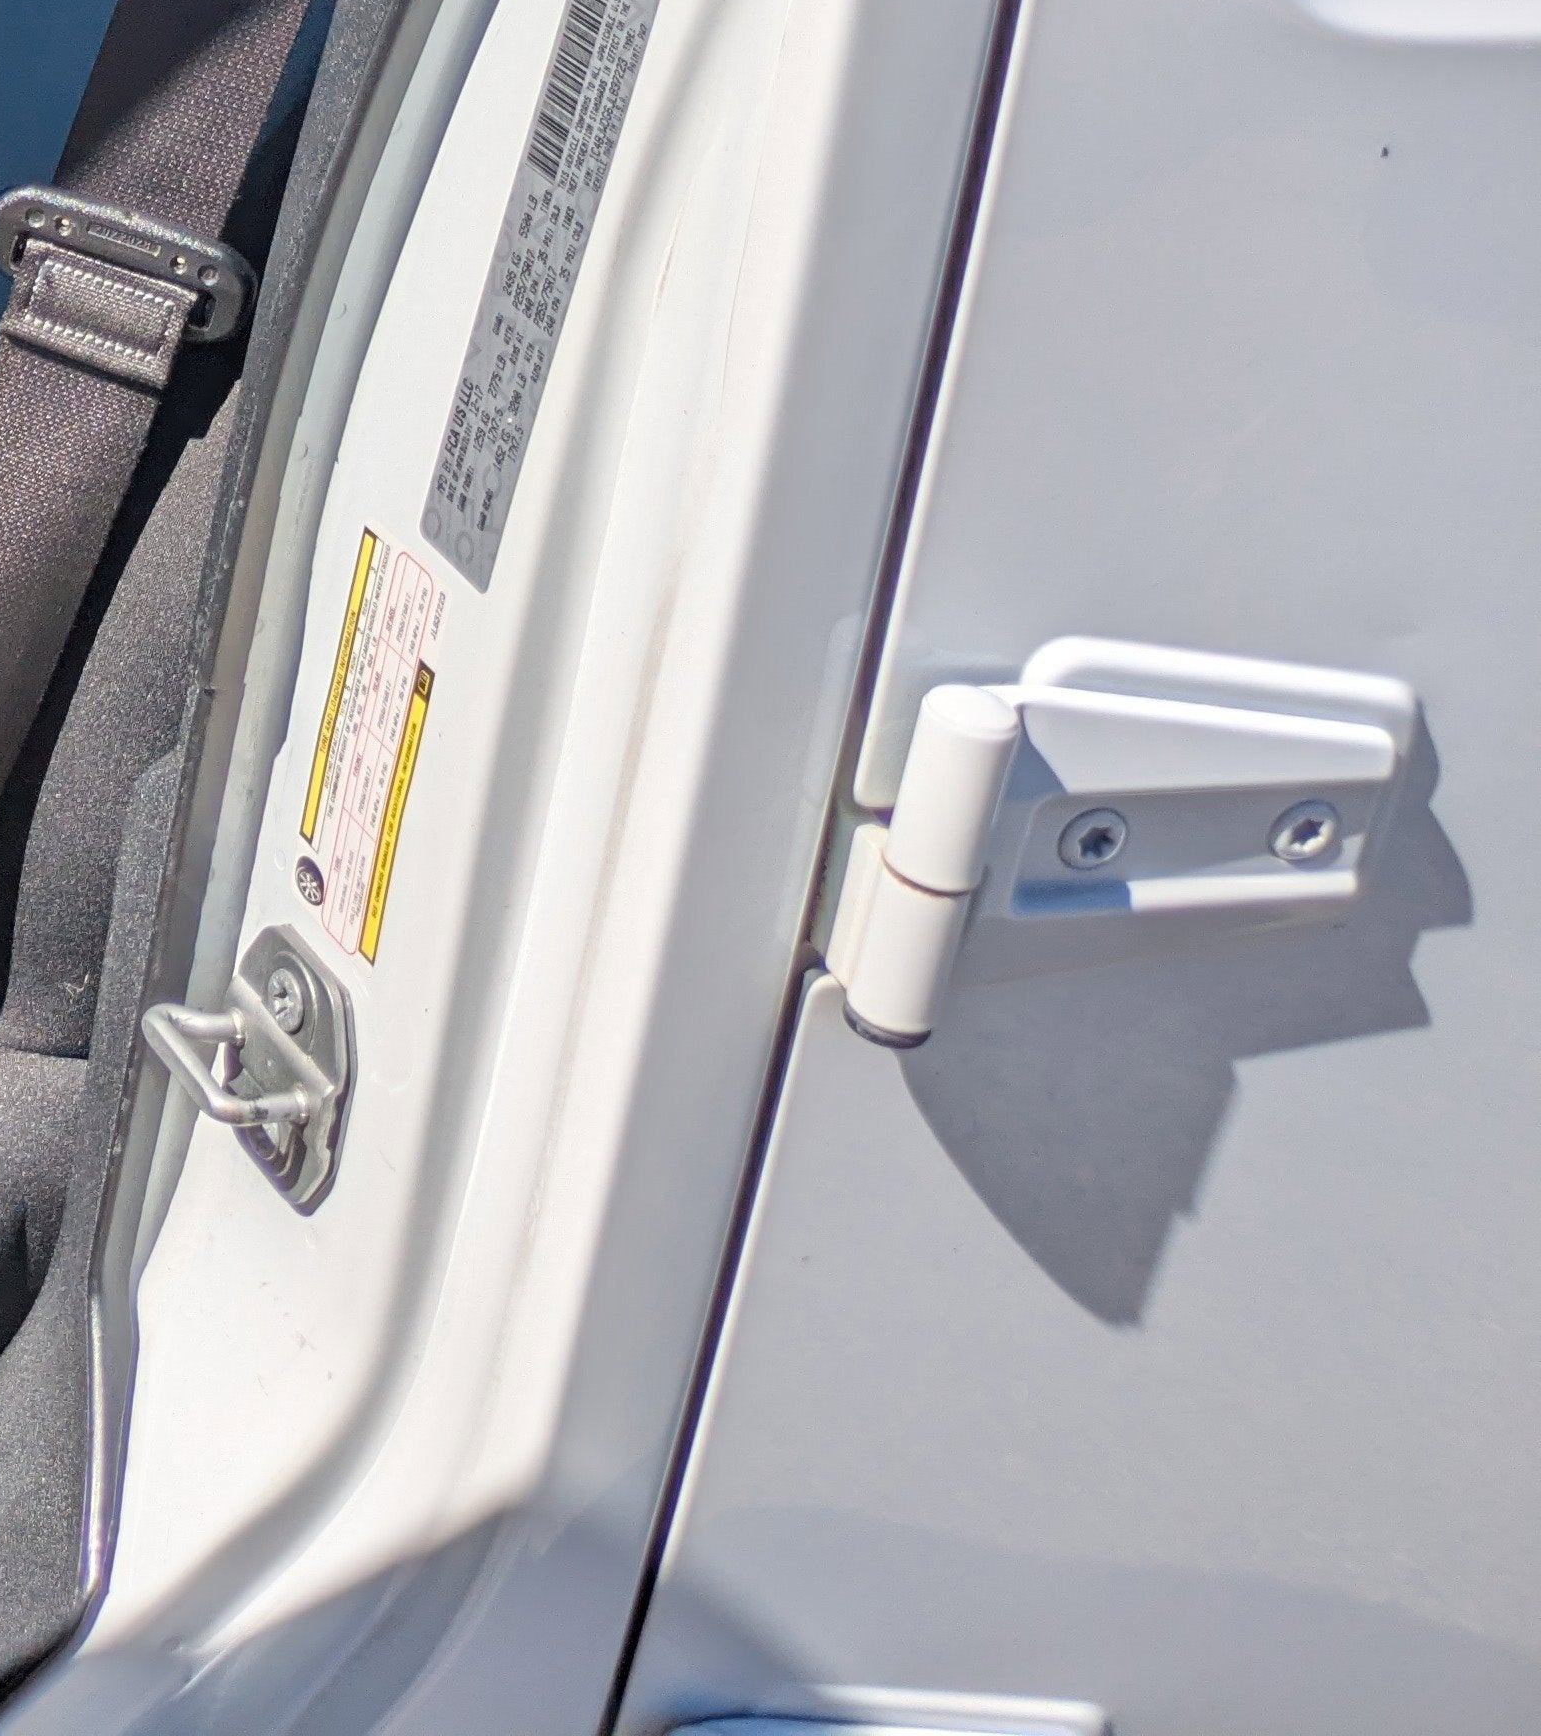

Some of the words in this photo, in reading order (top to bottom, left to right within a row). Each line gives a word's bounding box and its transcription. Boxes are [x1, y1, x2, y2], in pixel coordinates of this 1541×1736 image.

[619, 1, 630, 18] THE
[605, 33, 620, 64] EFFECT
[601, 64, 611, 76] IN
[558, 169, 569, 190] THIS
[564, 134, 579, 169] VEHICLE
[574, 94, 591, 134] CONFORMS
[590, 63, 601, 81] ALL
[602, 136, 614, 158] MADE
[609, 122, 618, 134] IN
[566, 171, 579, 197] THEFT
[510, 250, 521, 268] KG
[518, 210, 532, 239] 5500
[526, 193, 537, 211] LB
[472, 425, 486, 453] 1259
[479, 408, 490, 427] KG
[487, 369, 501, 399] 2775
[495, 353, 506, 372] LB
[511, 247, 536, 312] P255/75R17
[486, 405, 503, 444] 17X7.5
[521, 295, 534, 320] 240
[536, 248, 548, 266] 35
[492, 443, 506, 472] 1452
[499, 426, 511, 445] KG
[515, 371, 527, 389] LB
[532, 264, 557, 329] P255/75R17
[506, 423, 524, 463] 17X7.5
[542, 312, 556, 338] 240
[558, 265, 570, 283] 35
[458, 376, 474, 407] LLC
[469, 383, 484, 417] 12-17
[452, 404, 466, 429] US
[444, 425, 460, 457] FCA
[441, 457, 452, 474] BY
[361, 632, 371, 660] CARGO
[319, 733, 327, 755] TIRE
[324, 710, 332, 733] AND
[329, 670, 342, 714] LOADING
[338, 608, 355, 672] INFORMATION
